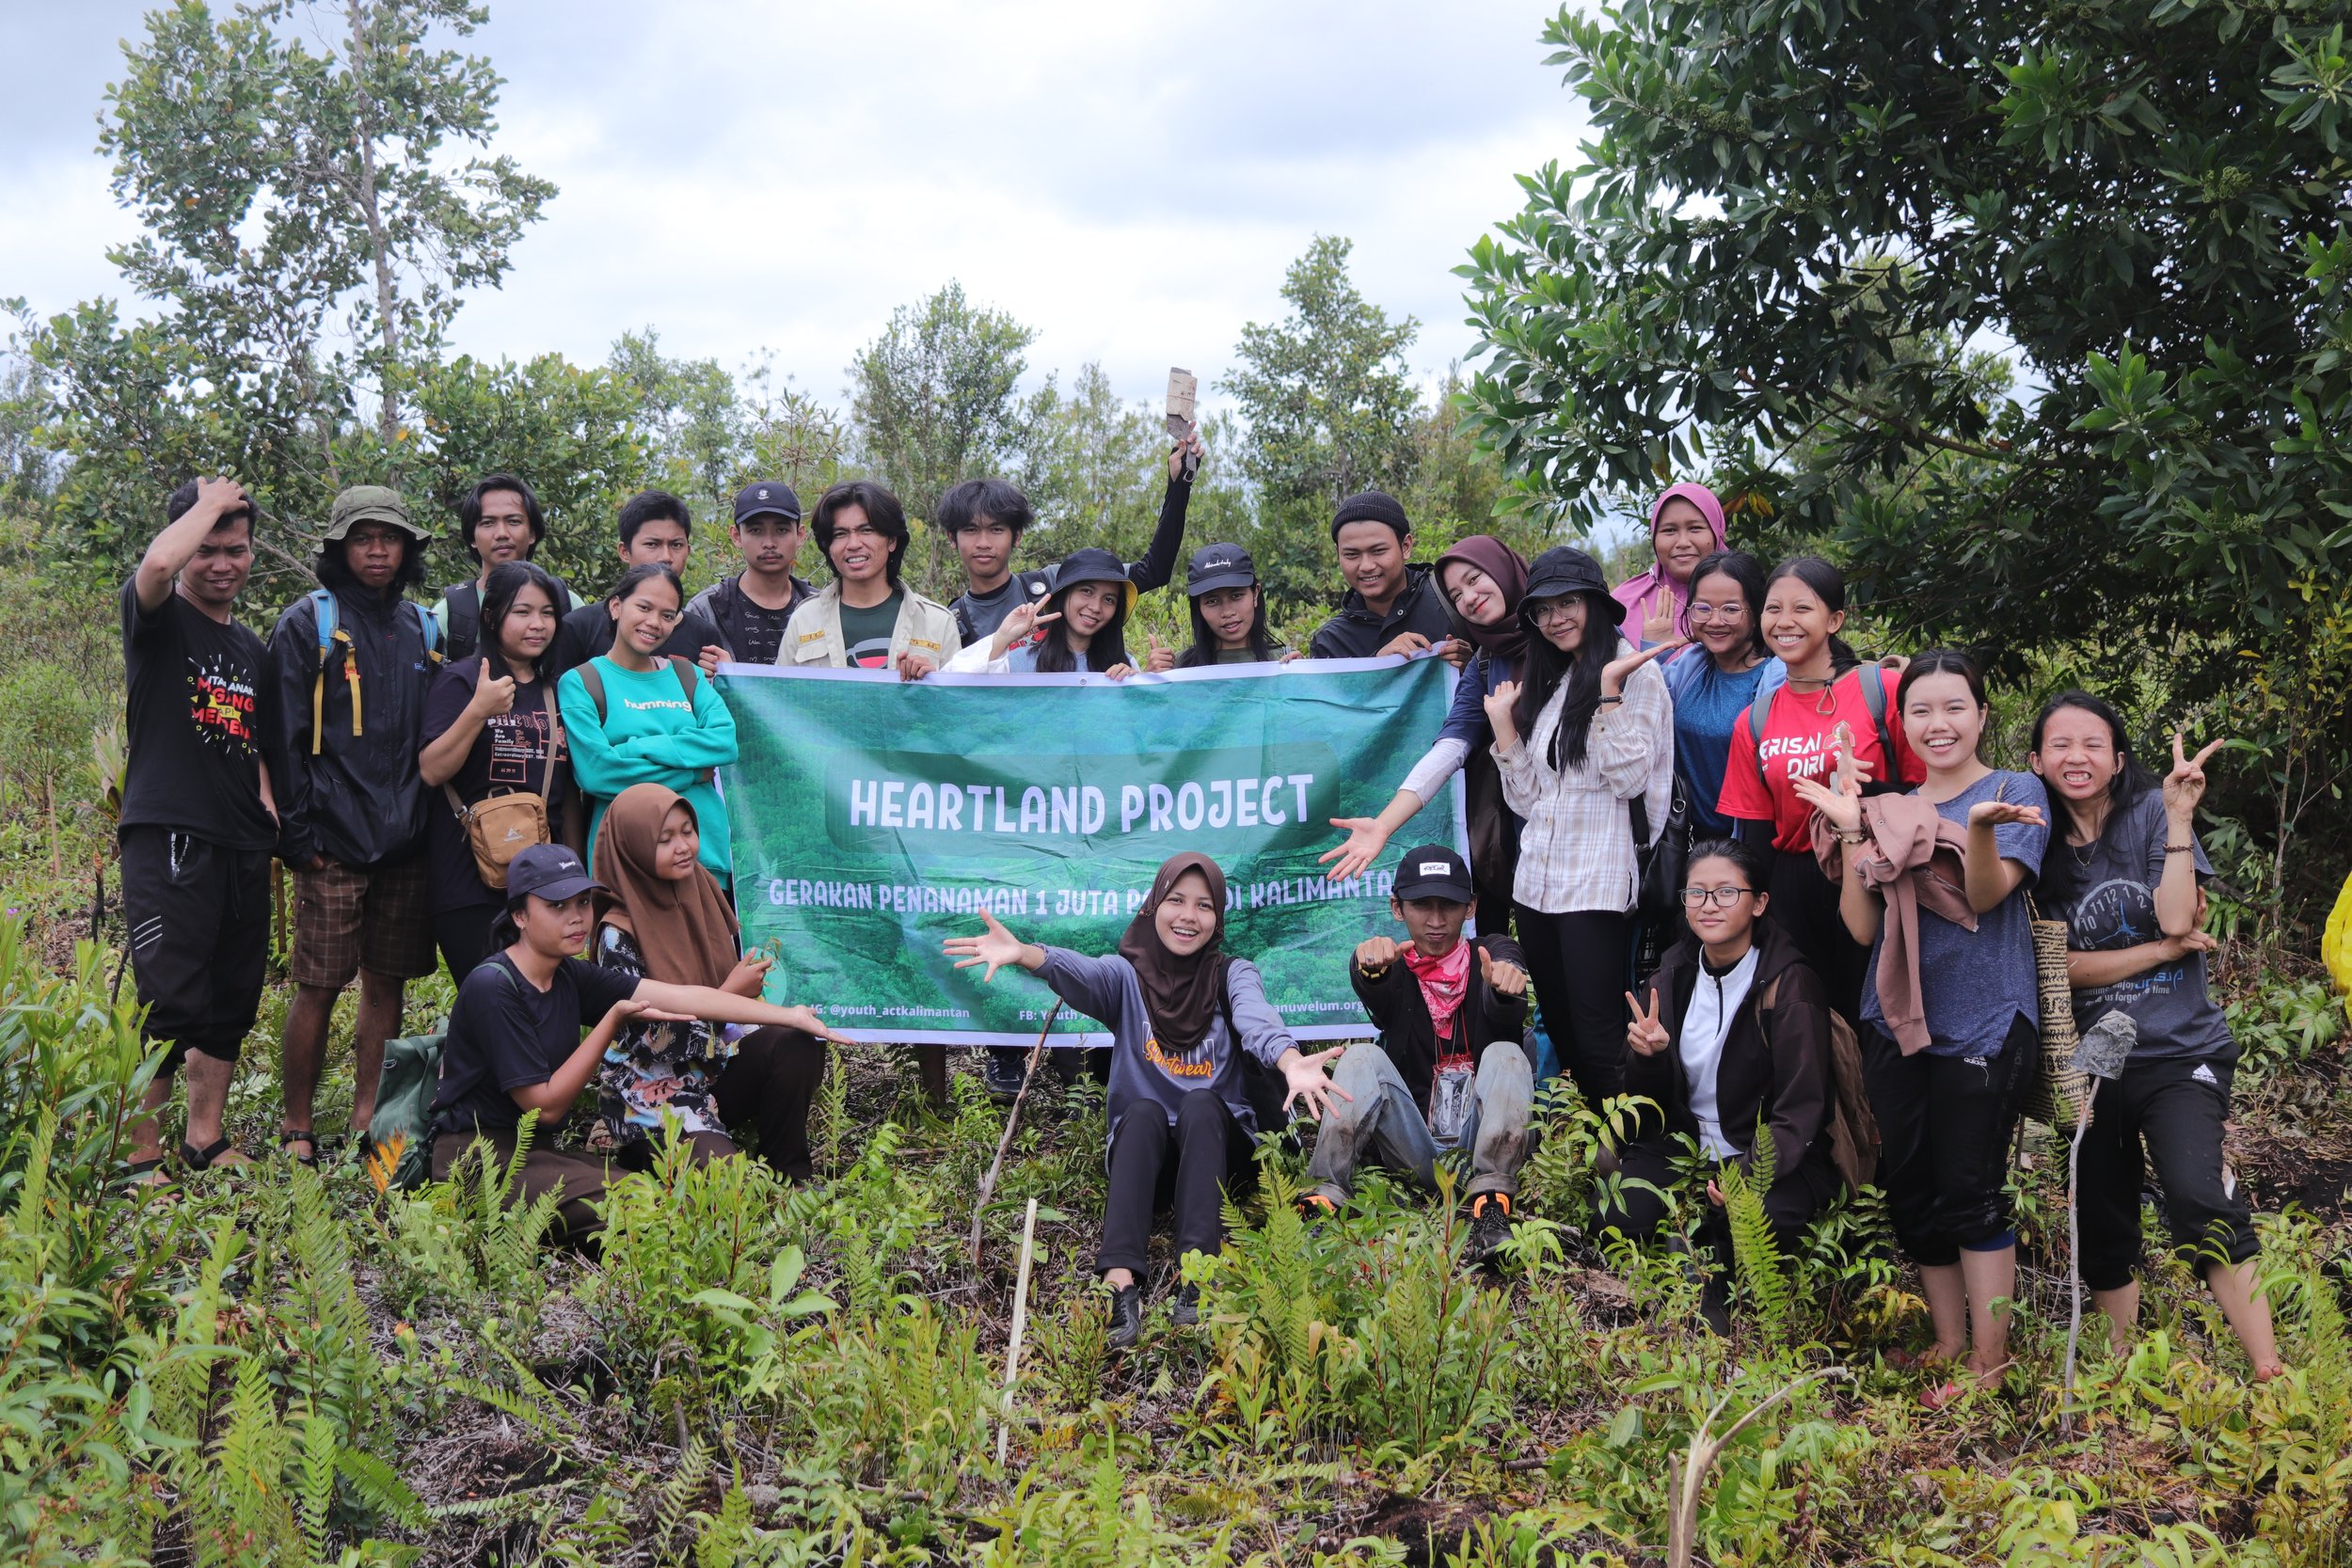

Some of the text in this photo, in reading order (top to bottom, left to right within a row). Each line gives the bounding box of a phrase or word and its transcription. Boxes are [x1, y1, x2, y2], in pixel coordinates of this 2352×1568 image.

[623, 697, 693, 713] humming
[1759, 732, 1822, 760] ERISAI
[1787, 752, 1825, 780] DIRI
[850, 773, 1313, 835] HEARTLAND PROJECT
[769, 878, 873, 910] GERAKAN
[879, 884, 1027, 915] PENANAMAN
[1035, 890, 1048, 915] 1
[1055, 889, 1118, 916] JUTA
[1250, 868, 1397, 910] KALIMANTA
[2104, 889, 2118, 903] 12
[2122, 885, 2130, 898] 1
[2090, 899, 2105, 914] 11
[2137, 895, 2147, 909] 2
[2081, 915, 2097, 931] 10
[2084, 936, 2096, 950] 9
[2104, 992, 2114, 1003] us
[2152, 984, 2170, 994] time
[830, 1004, 971, 1019] @youth_actkalimantan
[1274, 1000, 1365, 1014] anuwelum.org
[1019, 1009, 1038, 1022] FB:
[1040, 1008, 1078, 1022] Yuth
